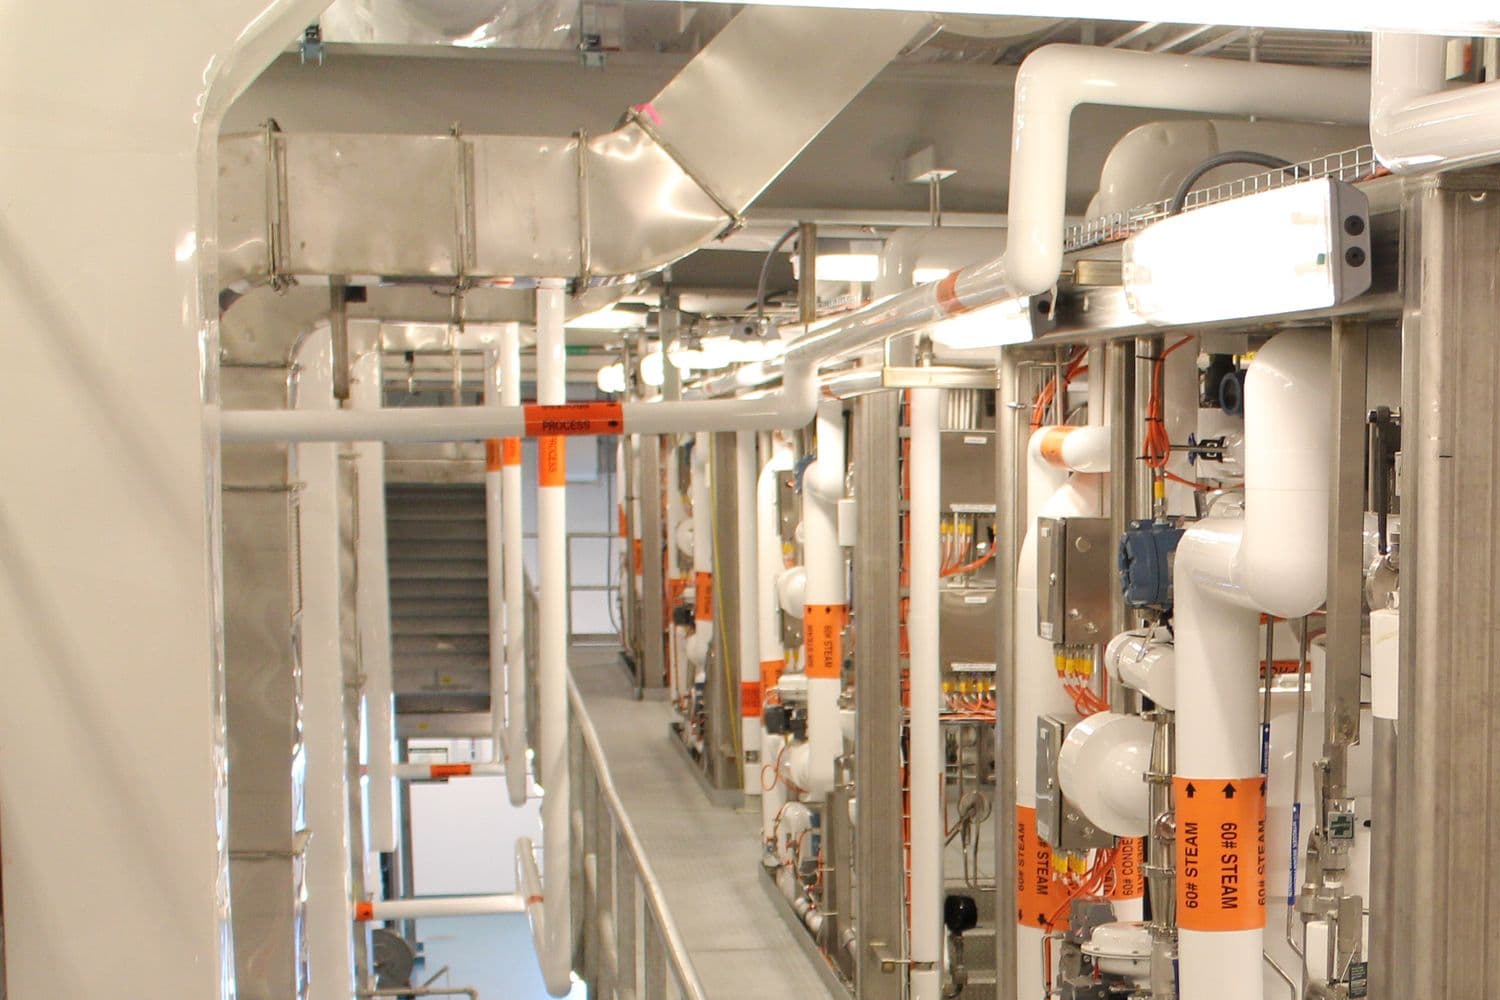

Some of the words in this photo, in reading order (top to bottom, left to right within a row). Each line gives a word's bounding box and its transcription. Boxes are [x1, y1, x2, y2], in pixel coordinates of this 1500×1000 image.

[1184, 822, 1199, 878] STEAM
[1221, 822, 1238, 849] 60#
[1036, 852, 1049, 895] STEAM
[1122, 880, 1133, 896] 60#
[1221, 854, 1238, 909] STEAM
[1185, 883, 1199, 909] 60#
